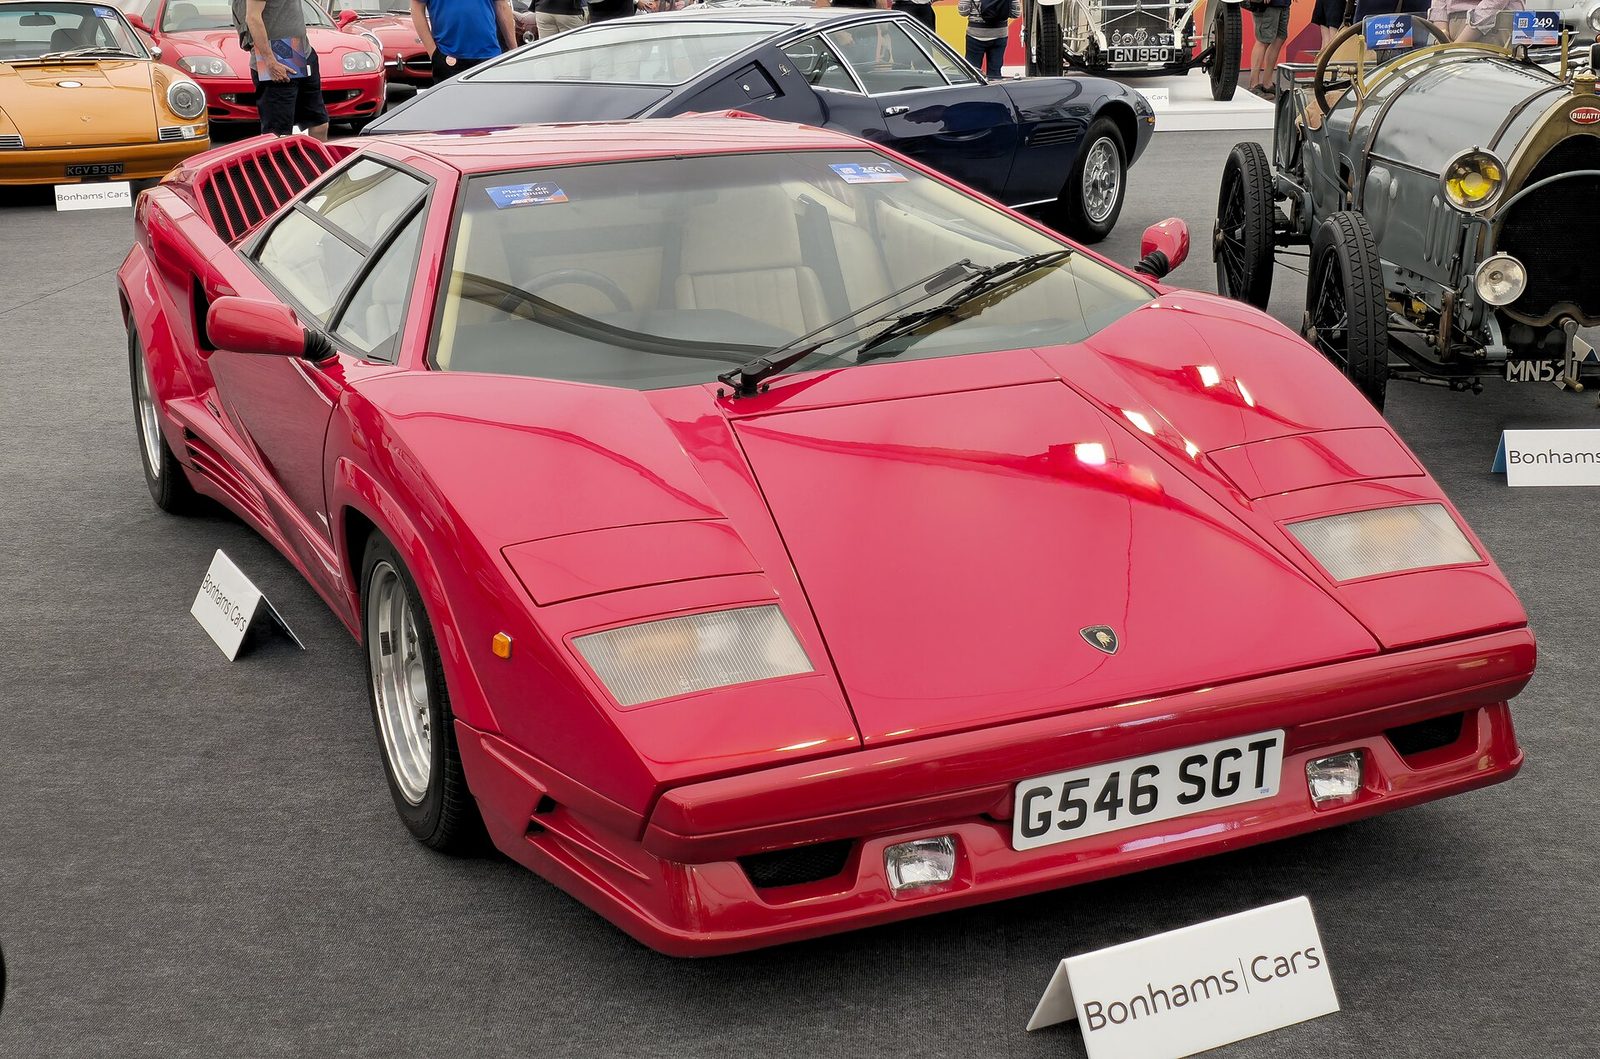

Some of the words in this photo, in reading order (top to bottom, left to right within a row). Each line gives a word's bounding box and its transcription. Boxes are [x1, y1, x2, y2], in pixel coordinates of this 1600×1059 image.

[1532, 17, 1554, 28] 249.
[57, 193, 104, 201] Bonhams
[202, 573, 231, 615] Bonhams
[230, 605, 247, 632] Cars
[1021, 764, 1160, 838] G546
[1176, 737, 1277, 805] SGT
[1083, 969, 1239, 1032] Bonhams
[1250, 947, 1320, 983] Cars
